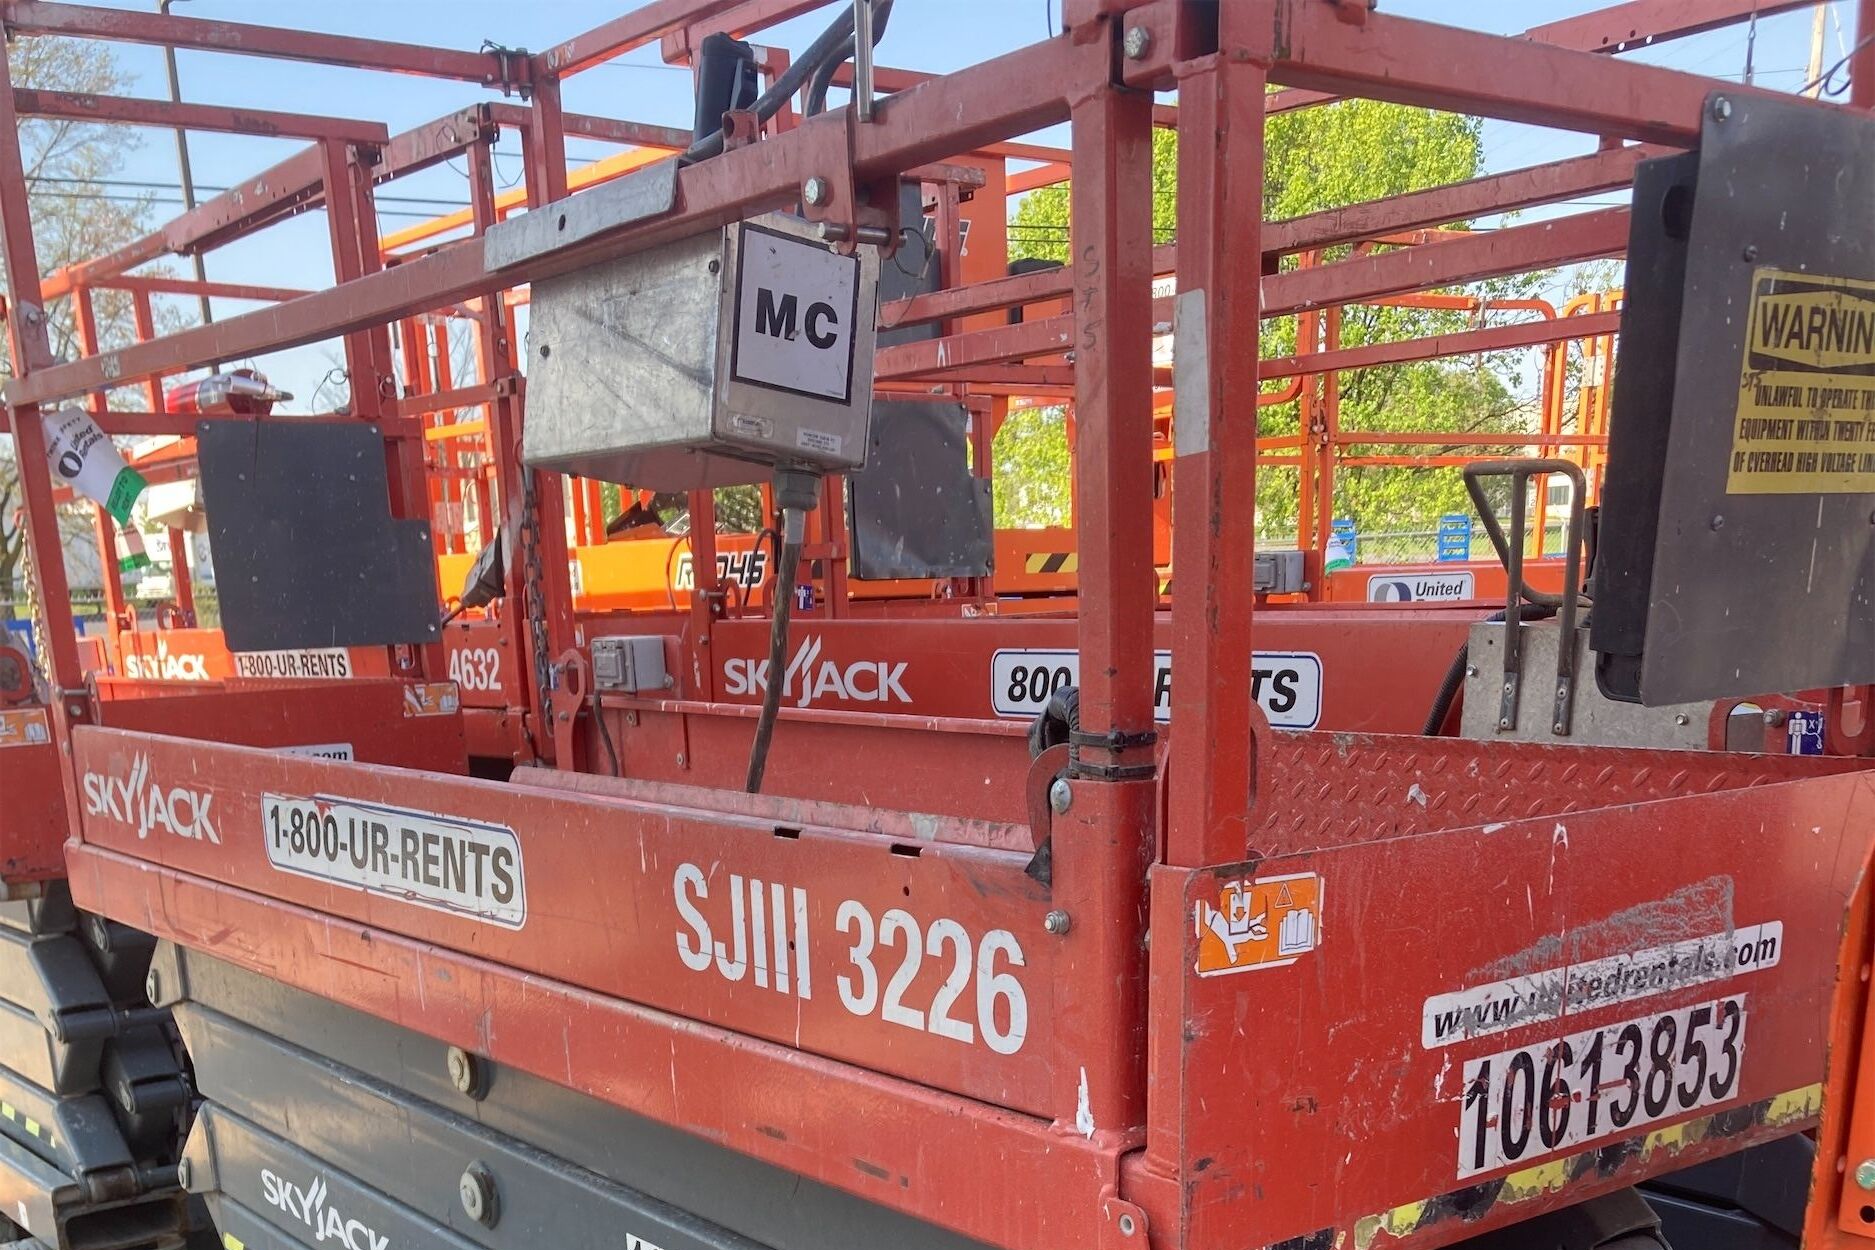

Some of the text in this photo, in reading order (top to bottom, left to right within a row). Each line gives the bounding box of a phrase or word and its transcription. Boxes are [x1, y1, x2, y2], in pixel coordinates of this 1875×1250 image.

[755, 287, 838, 350] MC
[1755, 385, 1802, 408] UNLAWFUL
[1807, 387, 1818, 408] TO
[1820, 388, 1857, 409] OPERATE
[1740, 418, 1795, 442] EQUIPMENT
[1797, 419, 1830, 441] WITHIN
[1834, 420, 1865, 441] TWENTY
[1733, 450, 1745, 473] OF
[1796, 452, 1818, 473] HIGH
[1820, 452, 1857, 473] VOLTAGE
[1416, 581, 1463, 597] United
[126, 641, 209, 681] SKYJACK
[238, 654, 347, 678] 1-800-UR-RENTS
[449, 648, 501, 690] 4632
[724, 634, 913, 708] SKYJACK
[84, 752, 221, 845] SKYJACK
[270, 804, 514, 905] 1-800-UR-RENTS
[674, 863, 1028, 1055] SJIII 3226
[1465, 1000, 1741, 1170] 10613853
